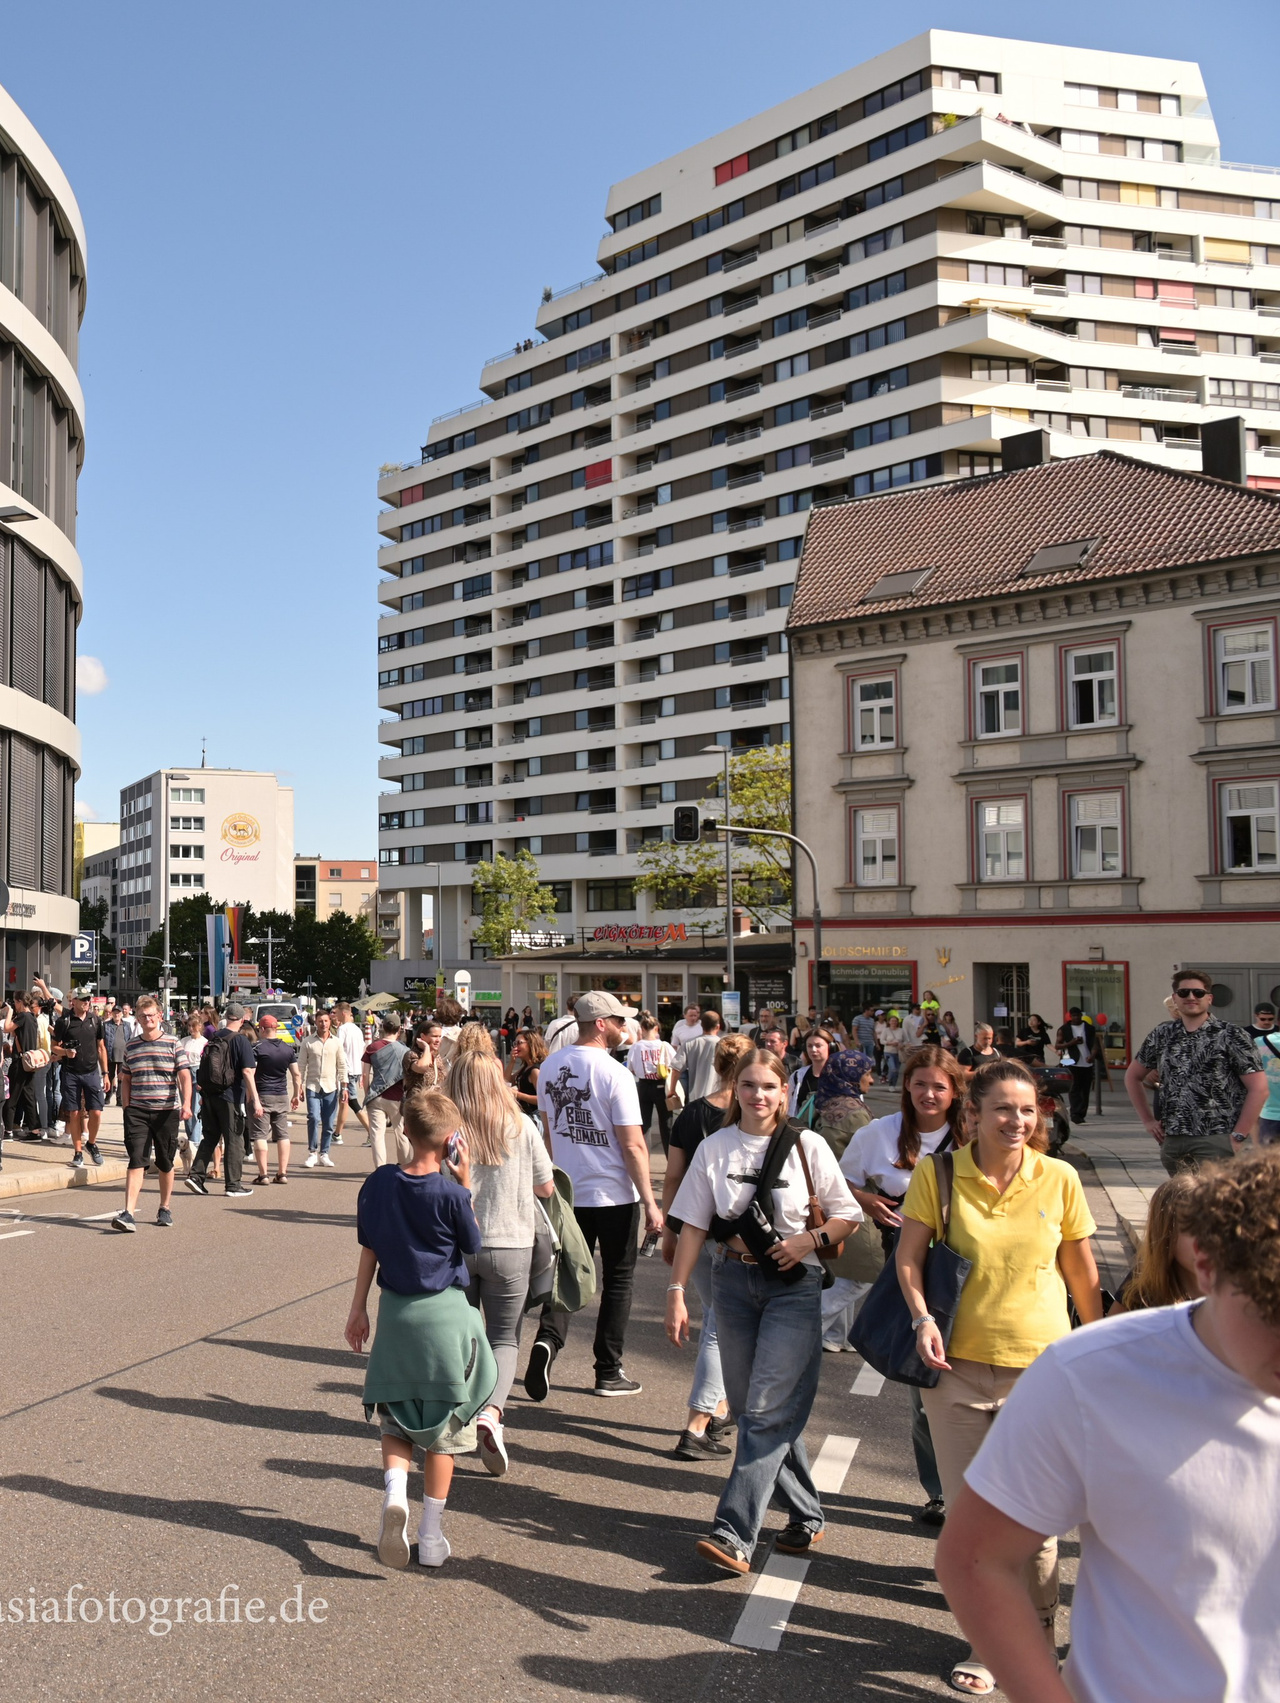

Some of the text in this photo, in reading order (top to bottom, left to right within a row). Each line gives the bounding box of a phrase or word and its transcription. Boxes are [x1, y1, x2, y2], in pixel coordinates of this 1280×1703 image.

[220, 847, 261, 865] Original
[75, 940, 89, 958] P
[871, 967, 910, 976] Danubius
[404, 979, 425, 990] Sal
[1069, 976, 1122, 984] PFANDHAUS
[766, 1000, 789, 1010] 100%
[565, 1106, 593, 1125] BLUE
[568, 1126, 609, 1145] TOMATO
